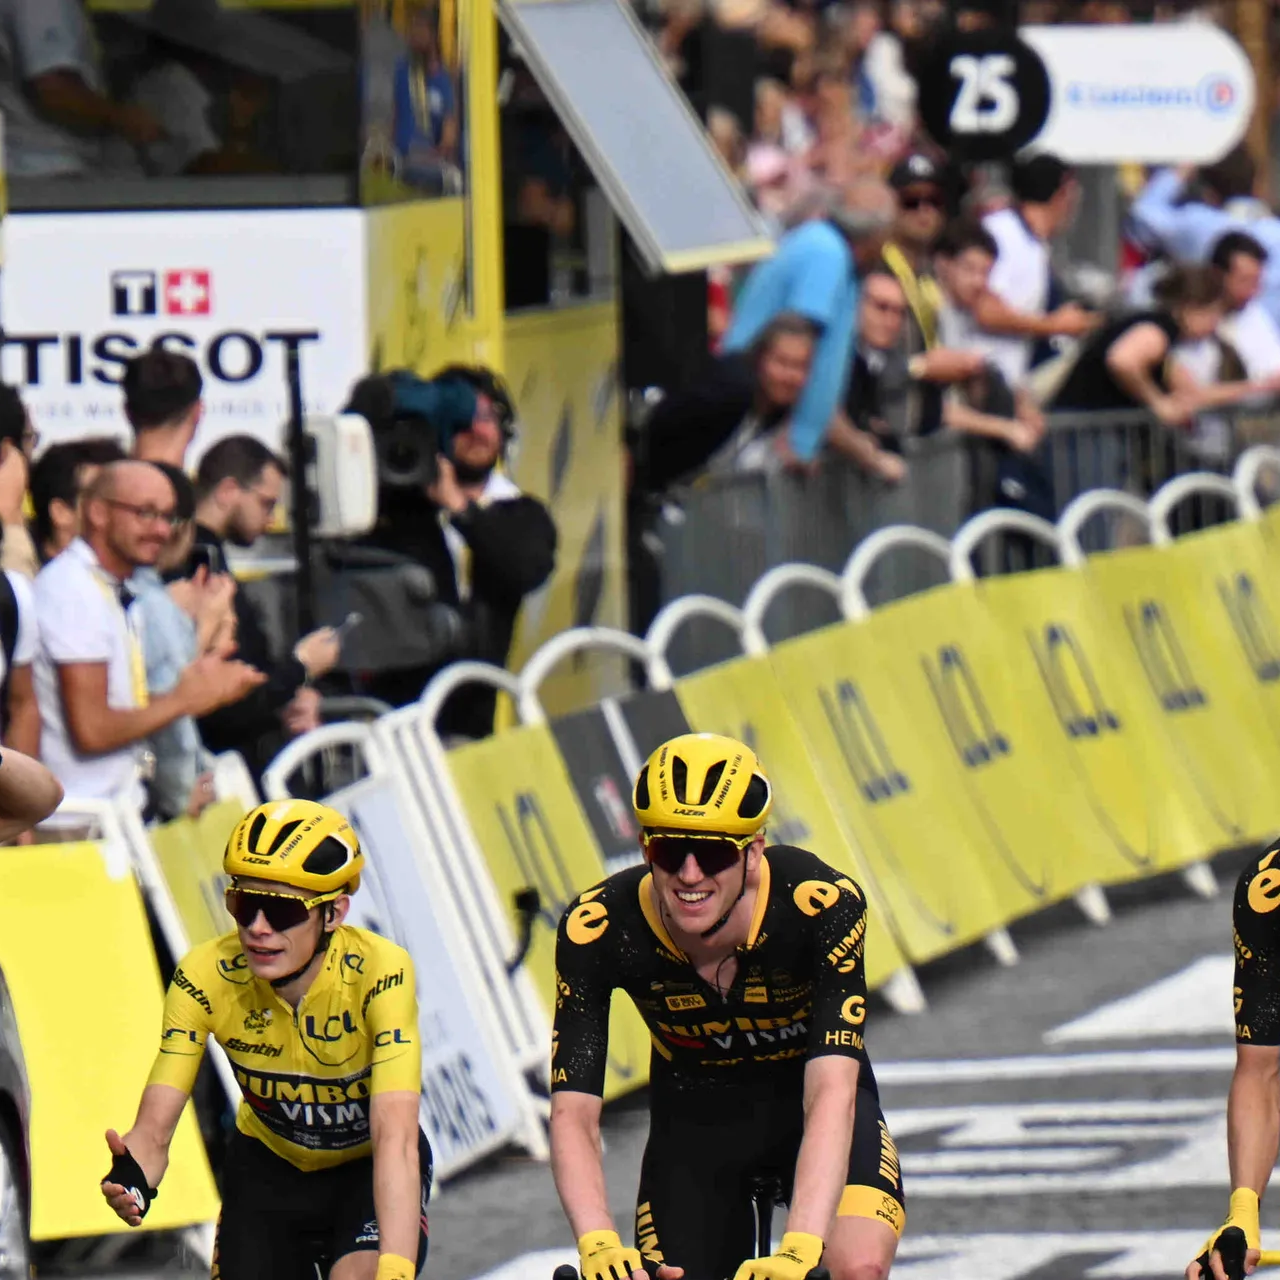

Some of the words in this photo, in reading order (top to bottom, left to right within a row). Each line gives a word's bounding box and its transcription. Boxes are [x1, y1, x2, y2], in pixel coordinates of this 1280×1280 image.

[948, 54, 1020, 134] 25
[715, 780, 732, 810] JUMBO
[673, 808, 706, 817] LAZER
[242, 855, 272, 867] LAZER
[279, 834, 304, 861] JUMBO
[219, 953, 249, 973] LC
[841, 994, 867, 1026] G
[305, 1010, 358, 1042] LCL
[374, 1028, 412, 1048] CL
[713, 1021, 808, 1050] VISM
[237, 1070, 371, 1104] JUMBO
[278, 1102, 366, 1127] VISM
[356, 1235, 380, 1244] AG
